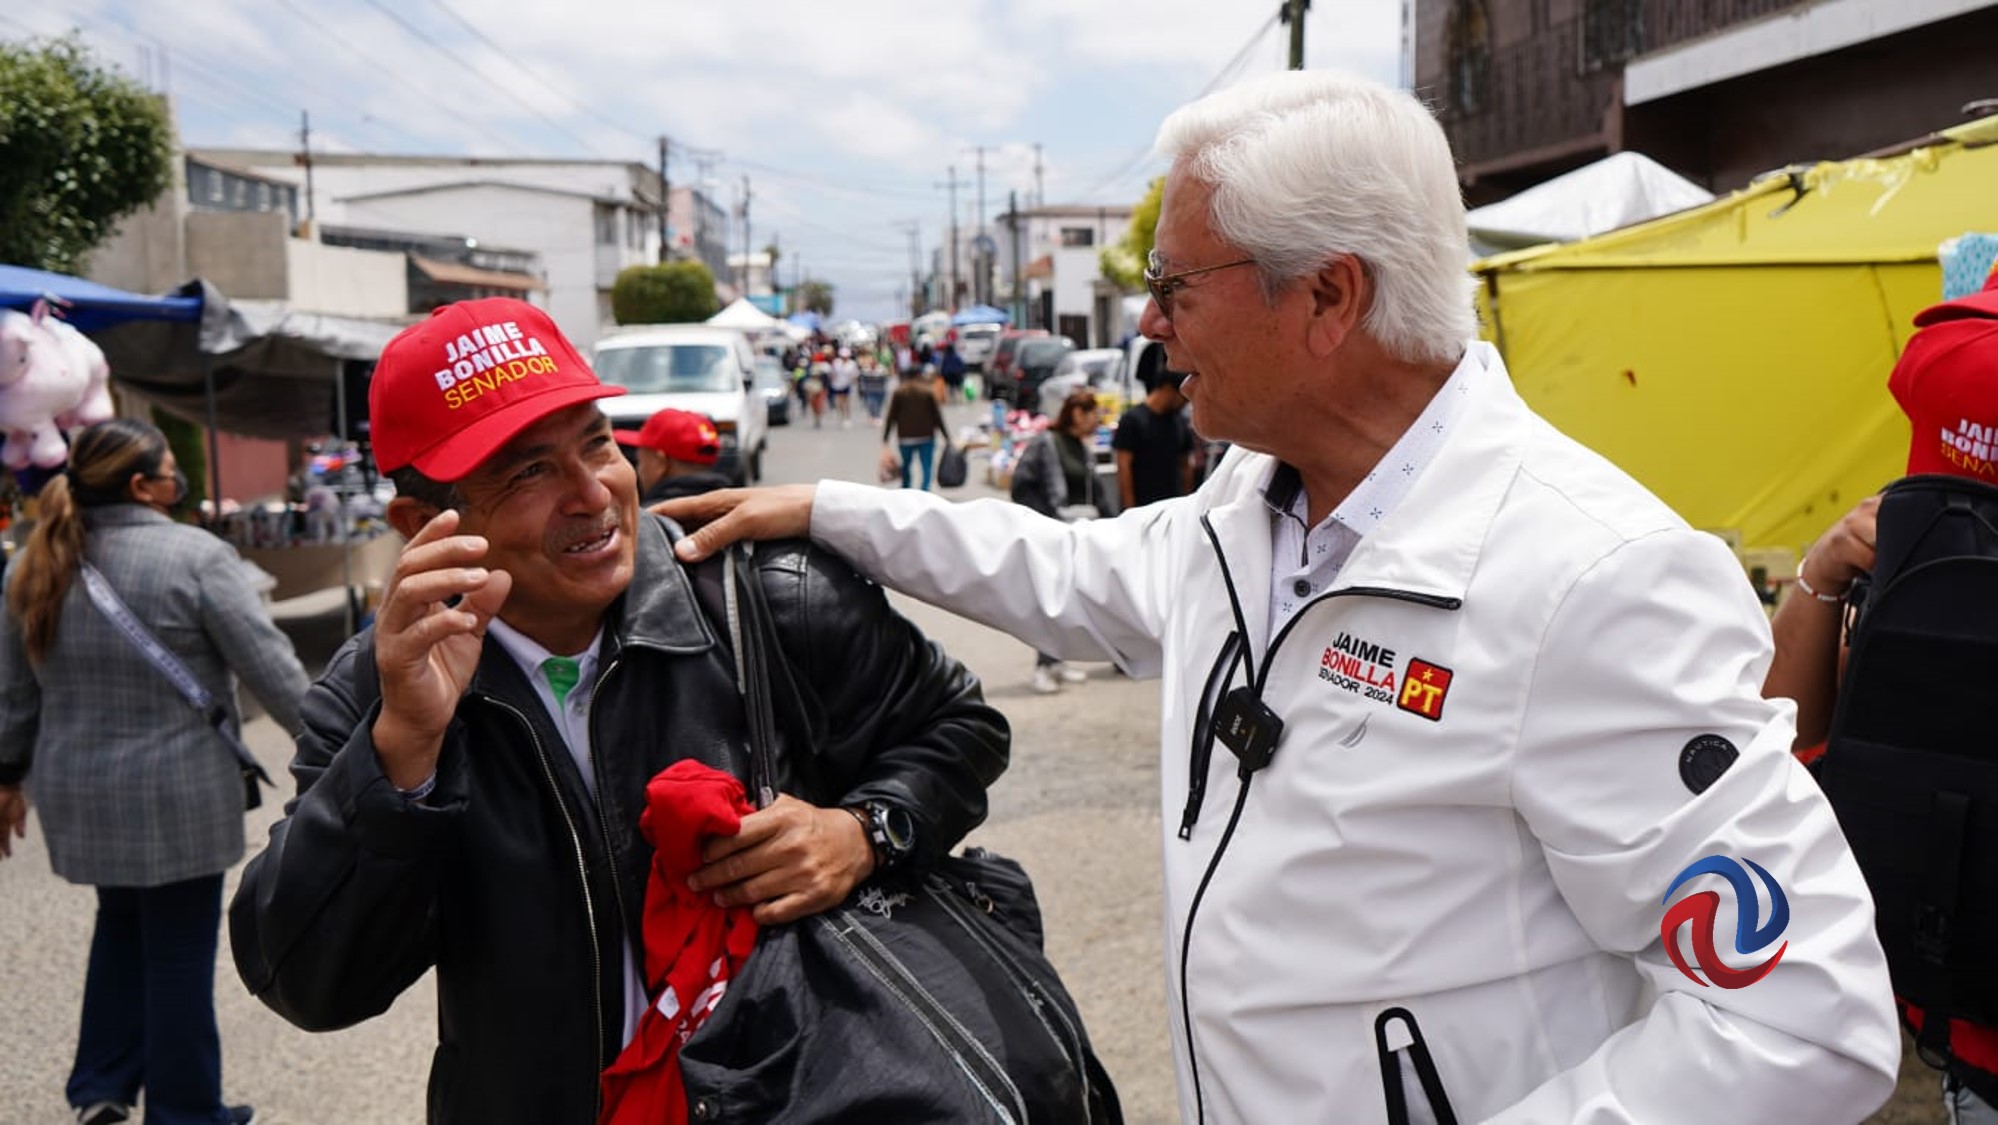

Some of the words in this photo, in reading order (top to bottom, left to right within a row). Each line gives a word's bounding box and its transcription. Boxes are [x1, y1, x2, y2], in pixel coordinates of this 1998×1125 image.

[445, 321, 524, 363] JAIME
[434, 337, 548, 392] BONILLA
[444, 356, 559, 410] SENADOR
[1321, 647, 1395, 692] BONILLA
[1333, 632, 1396, 668] JAIME
[1364, 686, 1394, 705] 2024
[1401, 677, 1443, 713] PT
[1685, 740, 1728, 763] NAUTICA
